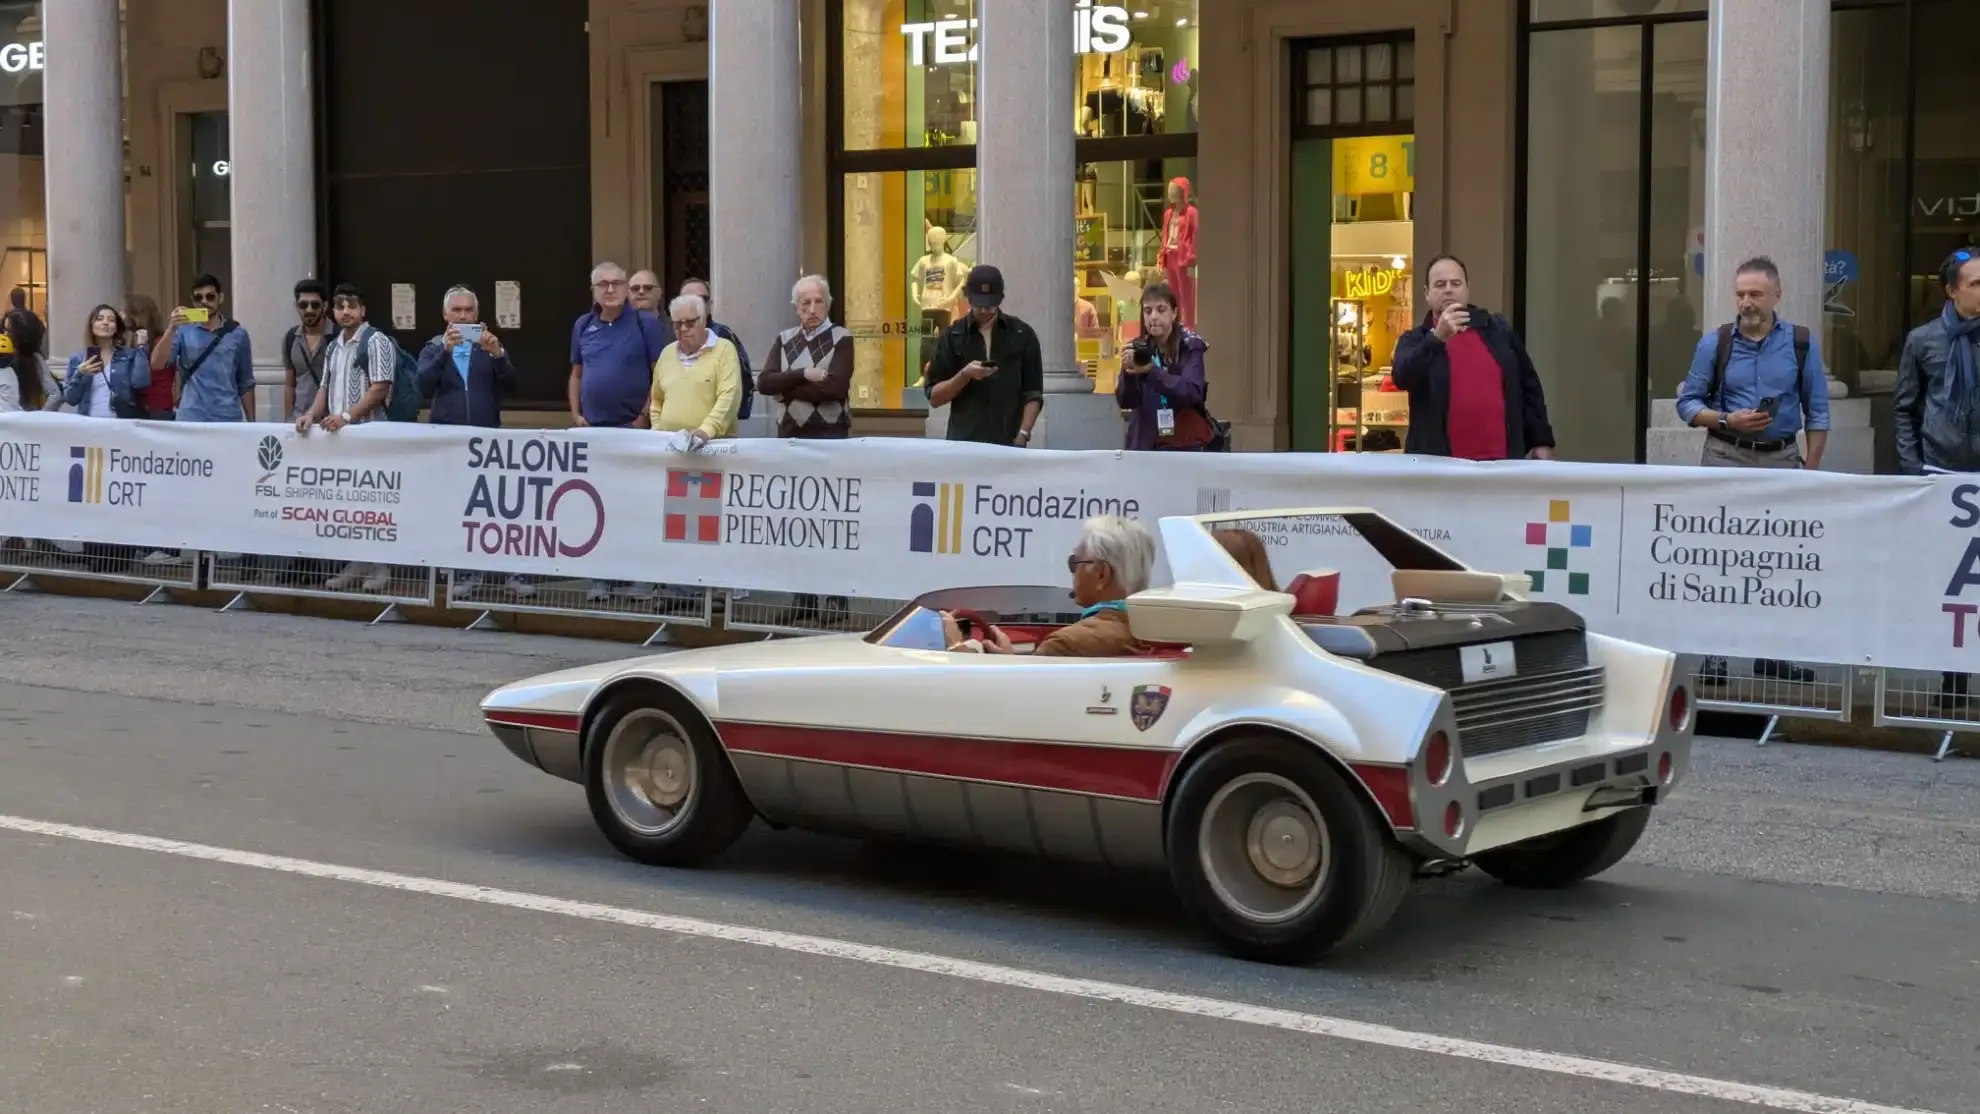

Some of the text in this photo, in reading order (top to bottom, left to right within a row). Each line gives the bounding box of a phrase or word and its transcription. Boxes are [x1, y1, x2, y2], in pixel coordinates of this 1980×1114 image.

[212, 160, 231, 176] G
[110, 449, 213, 477] Fondazione
[467, 437, 588, 473] SALONE
[255, 485, 280, 497] FSL
[286, 466, 401, 490] FOPPIANI
[108, 481, 147, 507] CRT
[285, 486, 400, 504] SHIPPING & LOGISTICS
[725, 473, 862, 513] REGIONE
[975, 485, 1140, 520] Fondazione
[254, 506, 397, 526] Part of SCAN GLOBAL
[1652, 503, 1825, 539] Fondazione
[316, 524, 397, 542] LOGISTICS
[725, 514, 860, 550] PIEMONTE
[973, 526, 1033, 558] CRT
[1651, 535, 1823, 579] Compagnia
[1649, 572, 1677, 600] di
